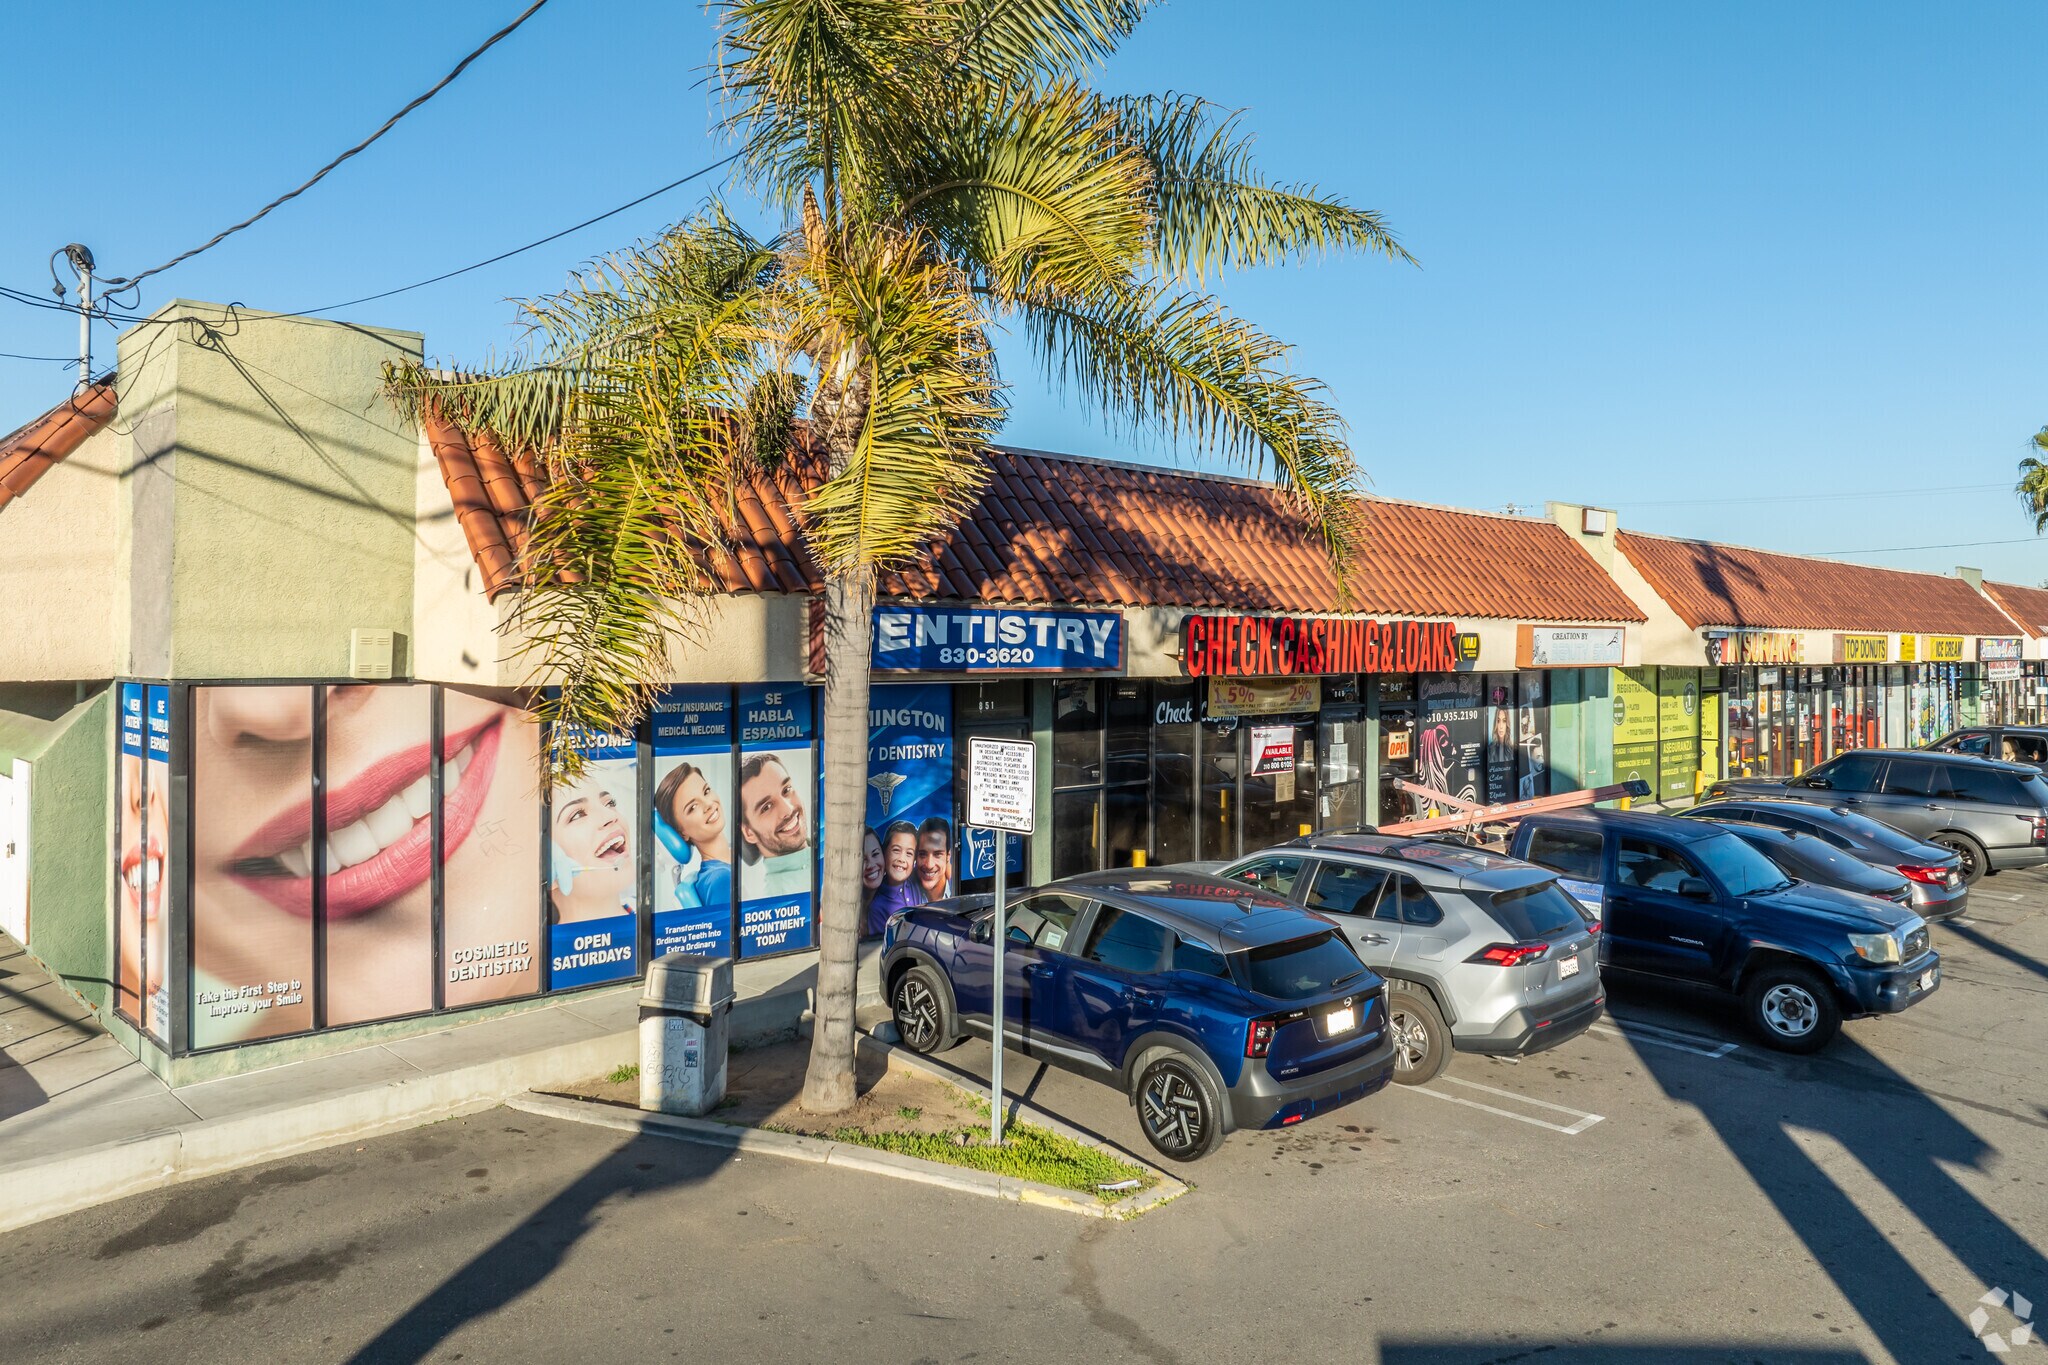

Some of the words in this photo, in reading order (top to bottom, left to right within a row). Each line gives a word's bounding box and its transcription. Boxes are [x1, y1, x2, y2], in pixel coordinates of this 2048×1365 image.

[871, 612, 1116, 660] ENTISTRY
[1187, 614, 1274, 677] CHECK
[1278, 616, 1378, 674] CASHING
[1396, 620, 1457, 673] LOANS
[1728, 632, 1804, 663] INSURANCE
[1846, 640, 1859, 659] TOP
[1861, 640, 1886, 659] DONUTS
[1936, 641, 1944, 657] ICE
[1945, 641, 1963, 657] CREAM
[940, 648, 1034, 664] 830-3620
[1624, 669, 1644, 681] AUTO
[1214, 686, 1254, 704] 1.5%
[1289, 685, 1312, 701] 2%
[1390, 682, 1402, 692] 847
[1617, 683, 1651, 693] REGISTRATION
[158, 700, 165, 713] SE
[764, 693, 782, 705] SE
[979, 701, 994, 711] 851
[660, 702, 682, 713] MOST
[683, 702, 724, 713] INSURANCE
[748, 708, 794, 723] HABLA
[1156, 701, 1192, 725] Check
[683, 714, 700, 724] AND
[1427, 710, 1478, 722] 310.935.2190
[658, 726, 690, 737] MEDICAL
[691, 724, 726, 736] WELCOME
[742, 723, 804, 741] ESPAÑOL
[879, 743, 945, 762] DENTISTRY
[1265, 747, 1292, 755] AVAILABLE
[1390, 742, 1408, 756] OPEN
[1663, 741, 1692, 753] ASEGURANZA
[744, 909, 772, 924] BOOK
[773, 905, 800, 918] YOUR
[664, 921, 713, 935] Transforming
[740, 916, 806, 938] APPOINTMENT
[573, 932, 612, 951] OPEN
[656, 935, 686, 947] Ordinary
[688, 931, 707, 941] Teeth
[708, 929, 722, 938] Into
[686, 940, 716, 952] Ordinary
[755, 932, 787, 948] TODAY
[1668, 936, 1704, 946] TACOMA
[451, 940, 529, 964] COSMETIC
[552, 946, 632, 972] SATURDAYS
[448, 956, 533, 983] DENTISTRY
[196, 992, 221, 1005] Take
[224, 987, 238, 1001] the
[240, 984, 263, 998] First
[267, 981, 289, 995] Step
[291, 979, 302, 990] to
[210, 1001, 248, 1018] Improve
[251, 998, 273, 1013] your
[276, 993, 302, 1007] Smile
